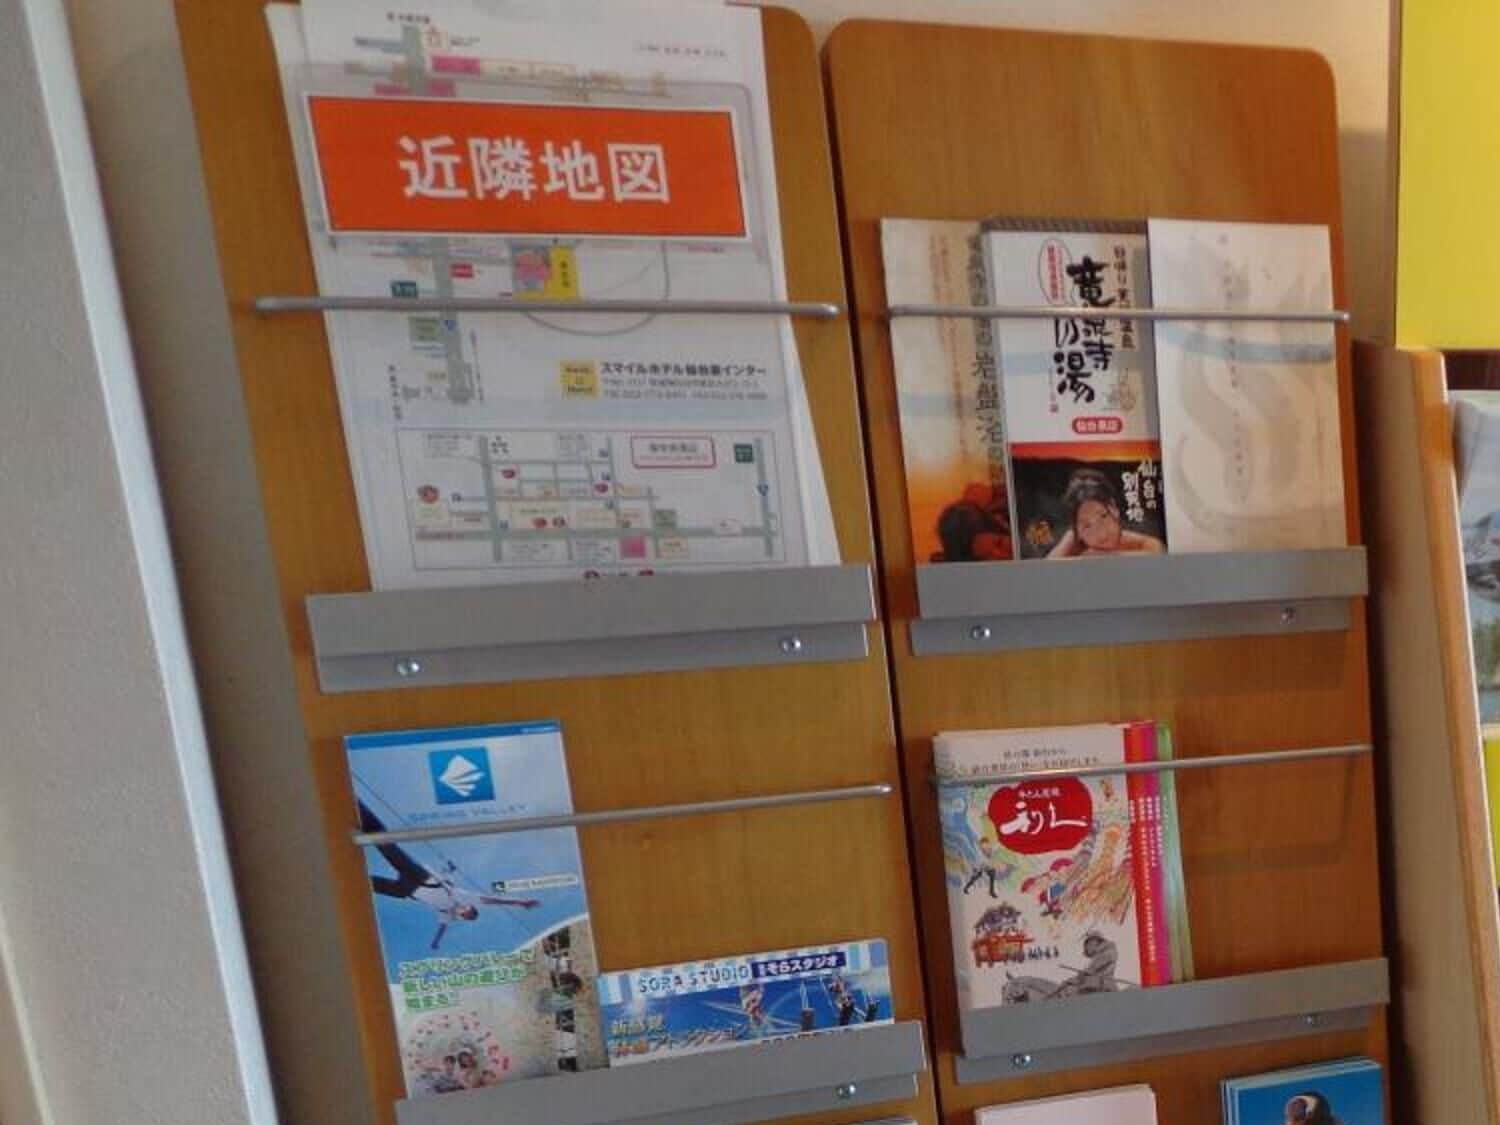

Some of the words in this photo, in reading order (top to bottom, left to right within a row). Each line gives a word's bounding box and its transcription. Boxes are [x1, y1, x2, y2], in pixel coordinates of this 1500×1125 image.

[397, 135, 671, 205] 近隣地図
[638, 974, 684, 993] SORA
[689, 963, 751, 988] STUDIO
